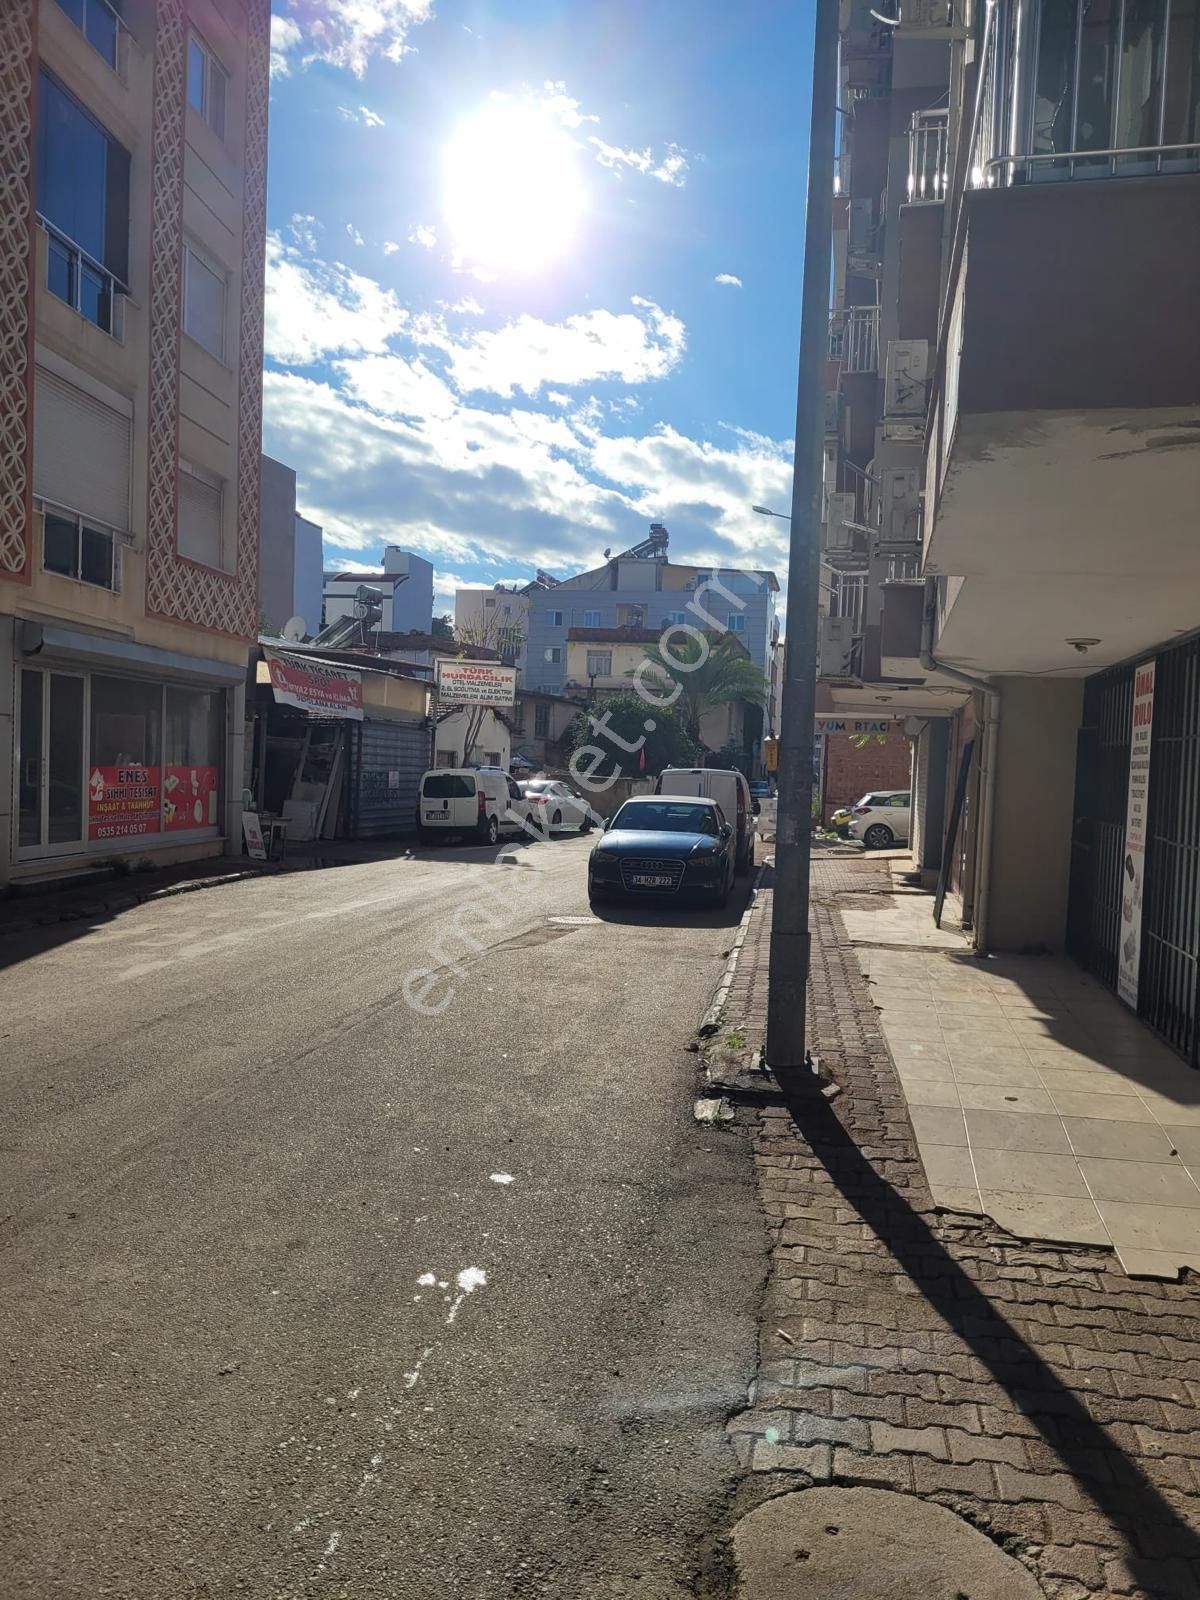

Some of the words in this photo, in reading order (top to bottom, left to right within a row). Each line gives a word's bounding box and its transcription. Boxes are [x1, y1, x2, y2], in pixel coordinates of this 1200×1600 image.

[462, 665, 494, 675] TÜRK
[442, 672, 513, 682] HURDACILIK
[1134, 701, 1152, 728] RULO
[118, 770, 148, 783] ENES
[98, 826, 114, 838] 0535
[117, 825, 128, 834] 214
[129, 824, 138, 834] 05
[139, 823, 147, 833] 07
